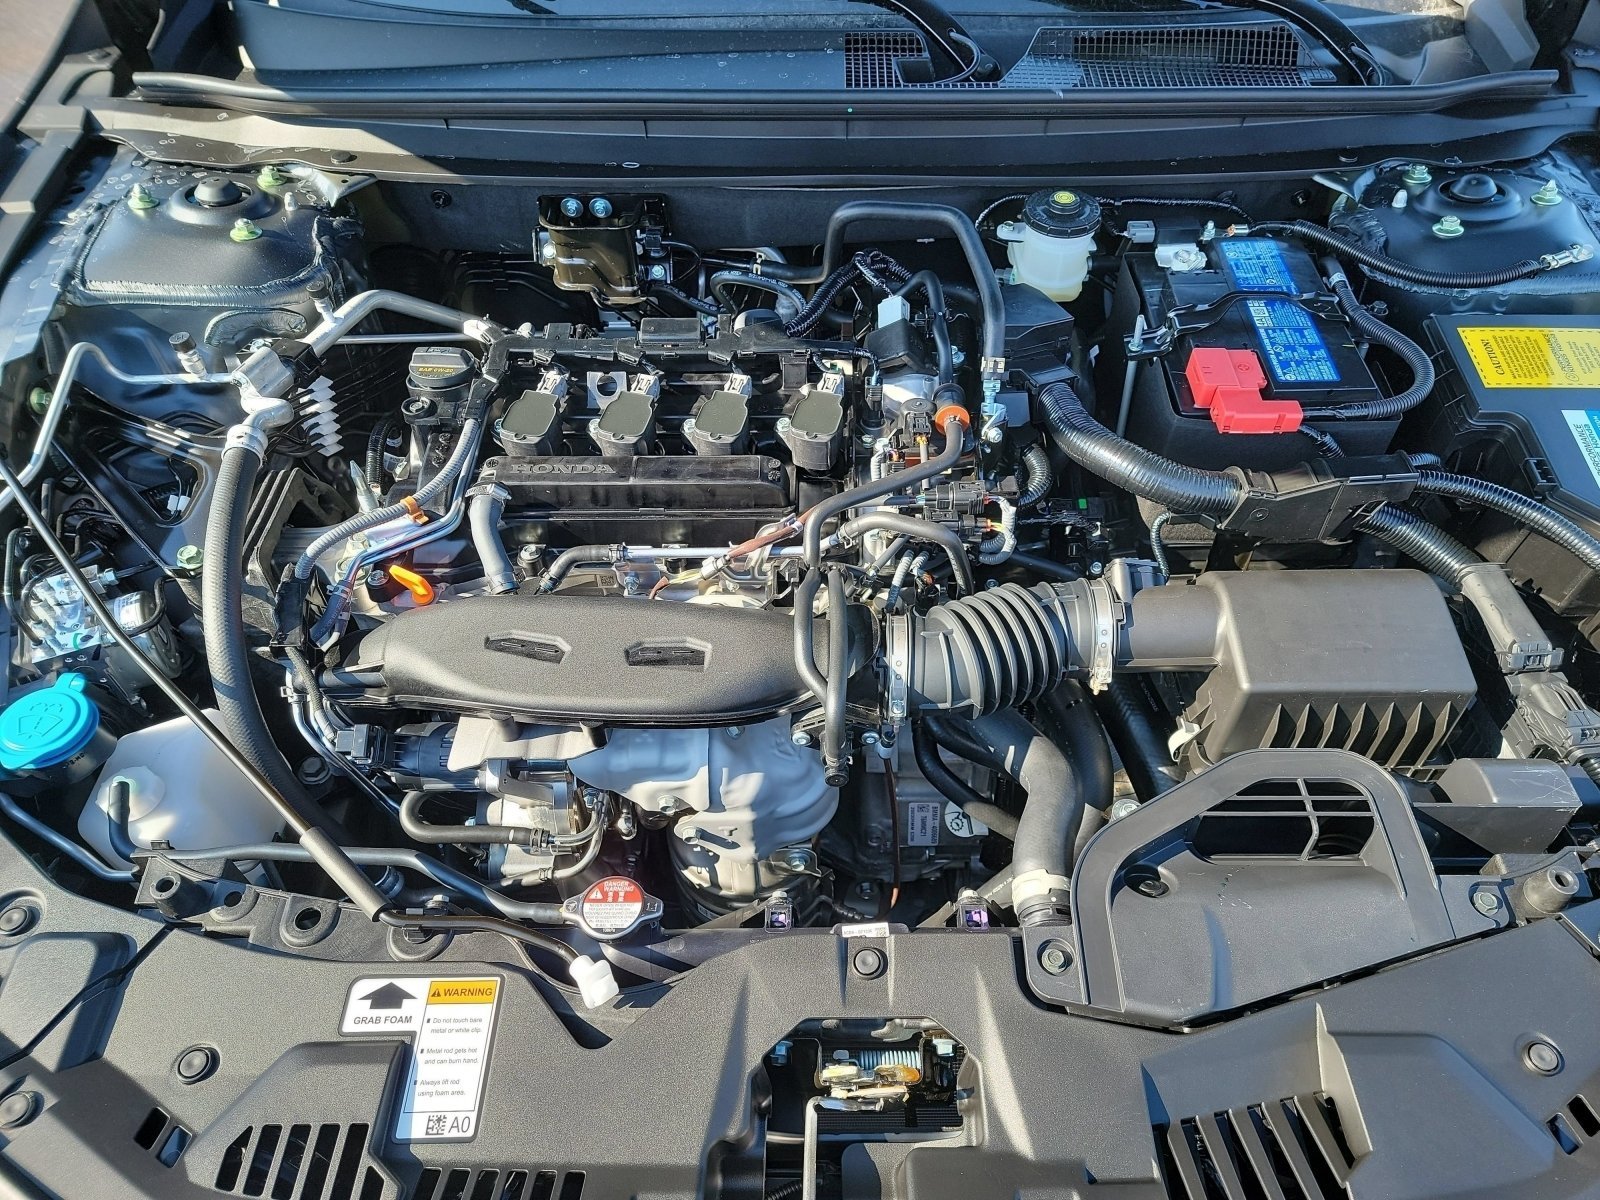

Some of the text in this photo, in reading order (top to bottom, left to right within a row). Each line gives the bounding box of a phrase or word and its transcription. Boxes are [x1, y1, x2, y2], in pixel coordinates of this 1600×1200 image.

[1480, 339, 1505, 374] CAUTION!
[510, 463, 617, 474] HONDA
[443, 988, 493, 997] WARNING
[353, 1015, 413, 1025] GRAB FOAM
[448, 1116, 471, 1134] A0
